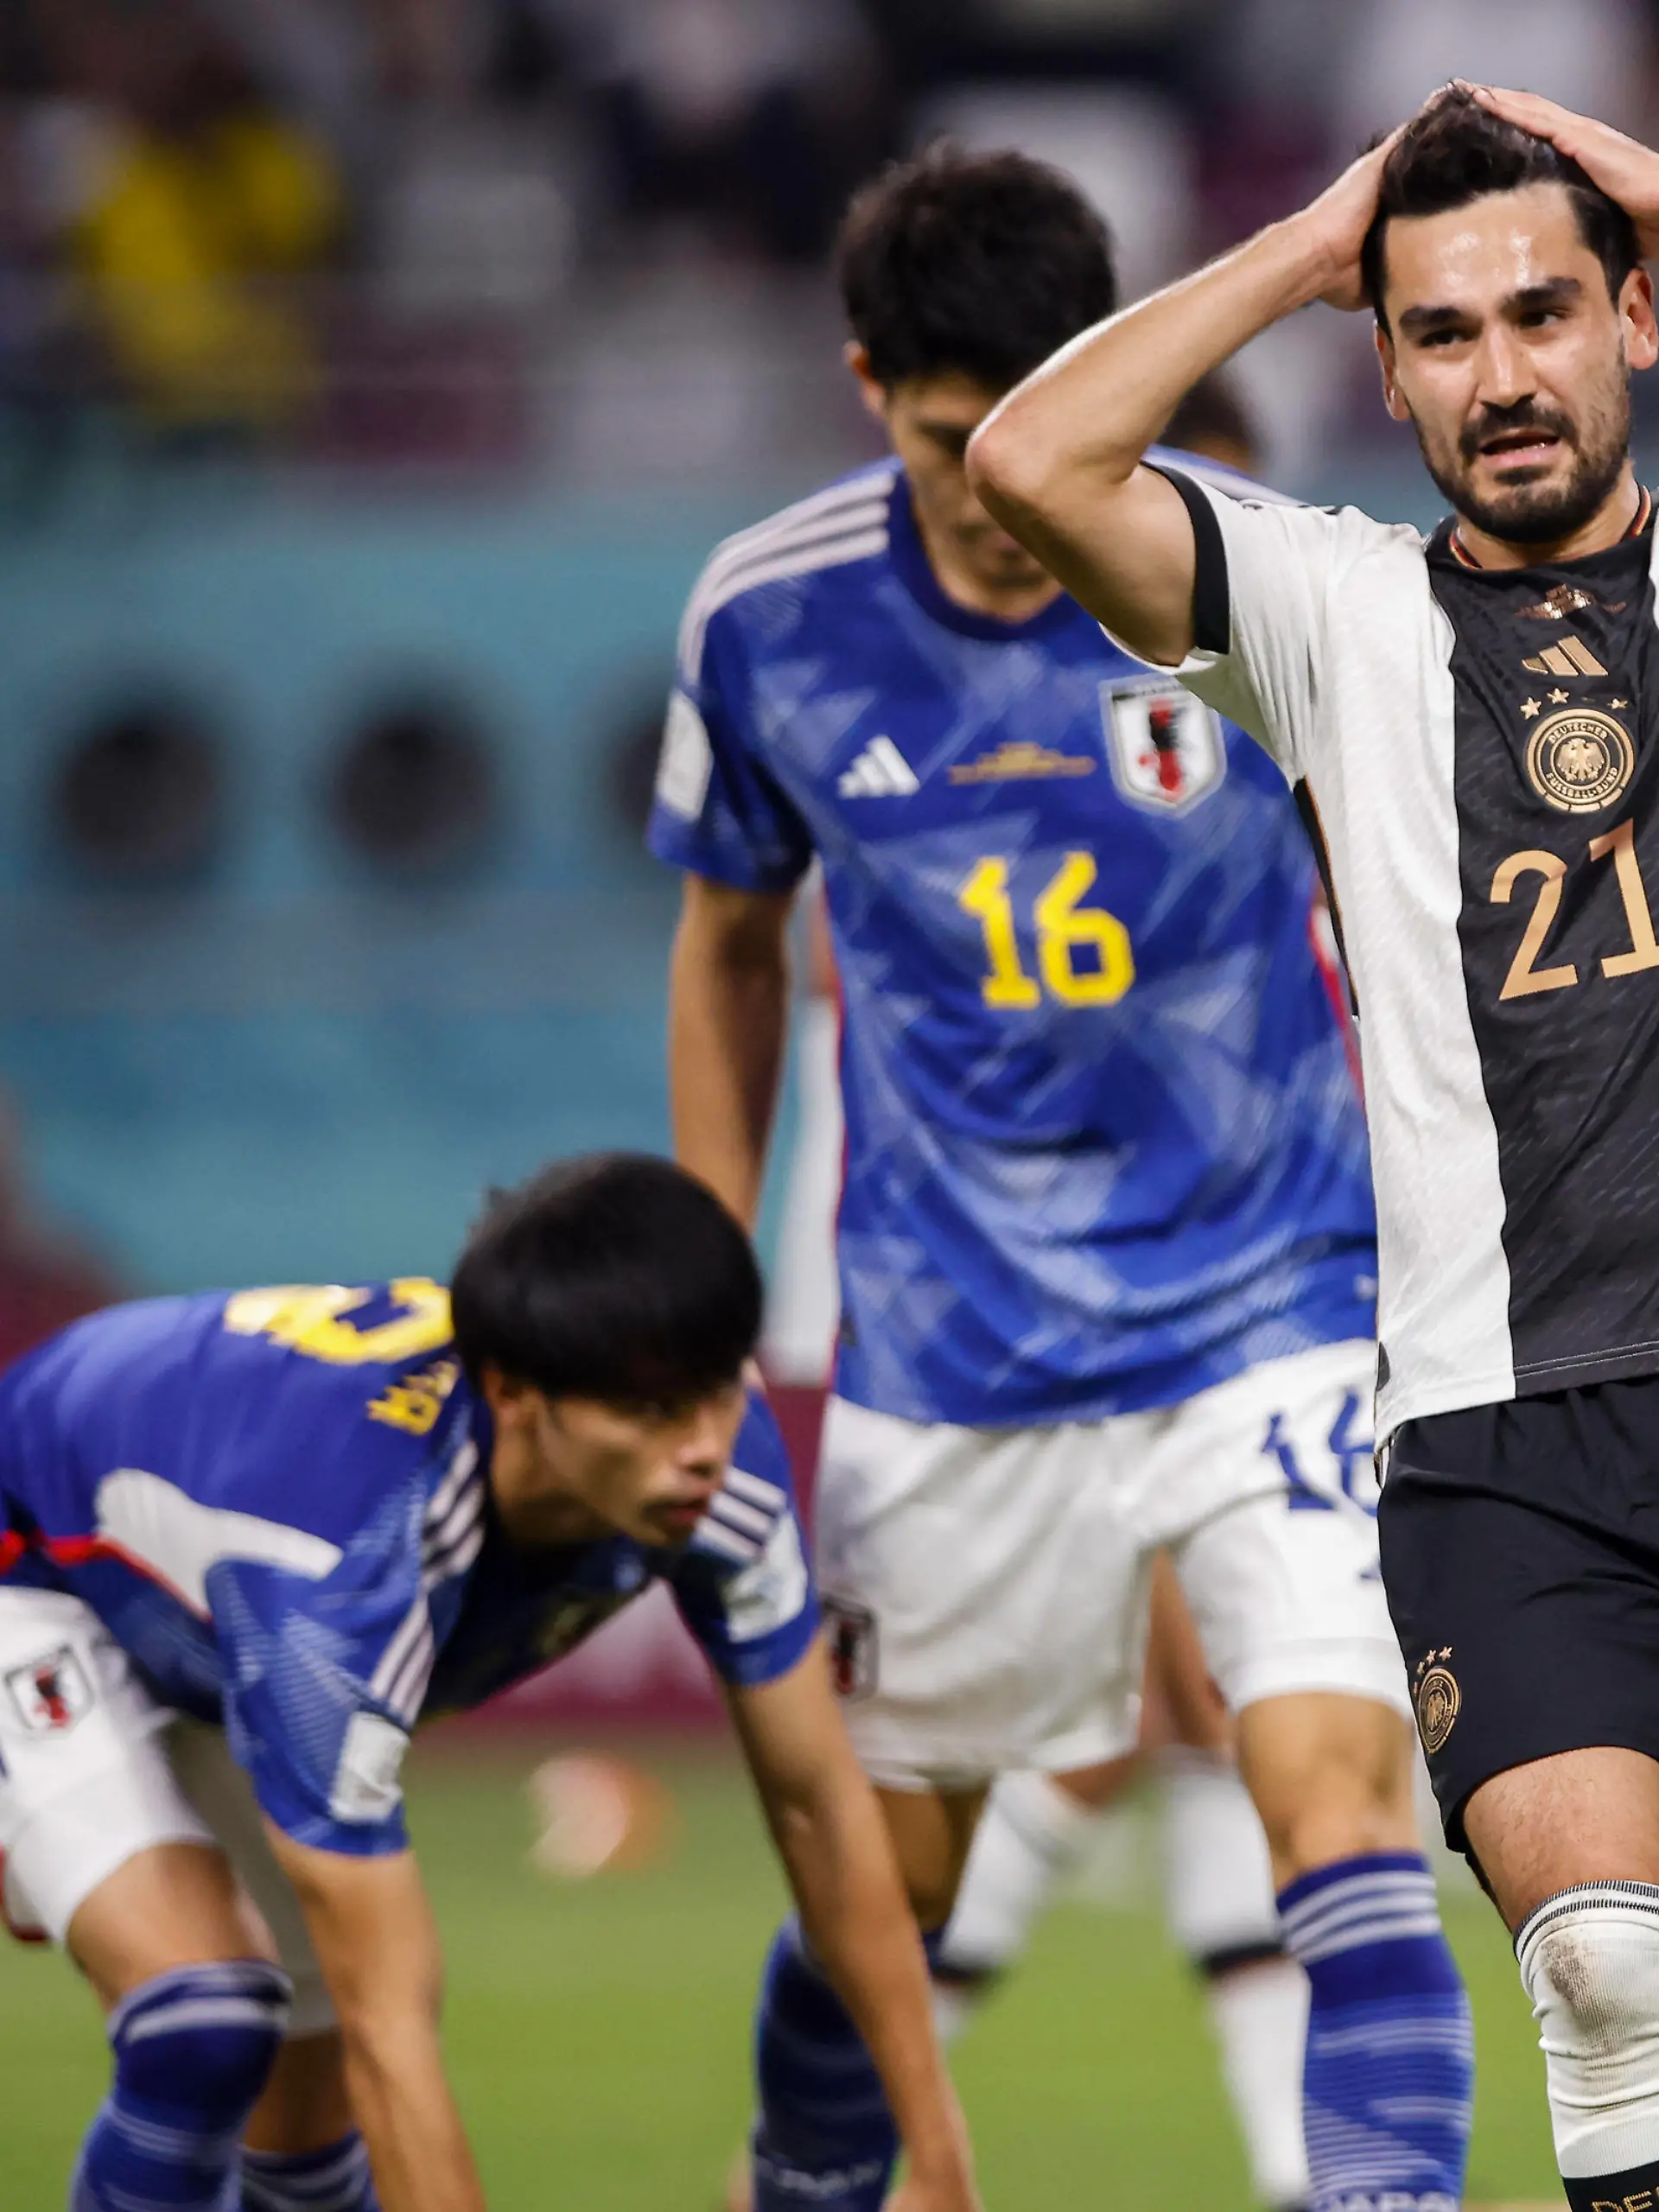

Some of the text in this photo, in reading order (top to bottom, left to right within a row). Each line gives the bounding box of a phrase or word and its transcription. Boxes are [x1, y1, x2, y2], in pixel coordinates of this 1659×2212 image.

[1548, 722, 1608, 743] DEUTSCHER
[960, 850, 1135, 1011] 16
[1490, 817, 1659, 1001] 21
